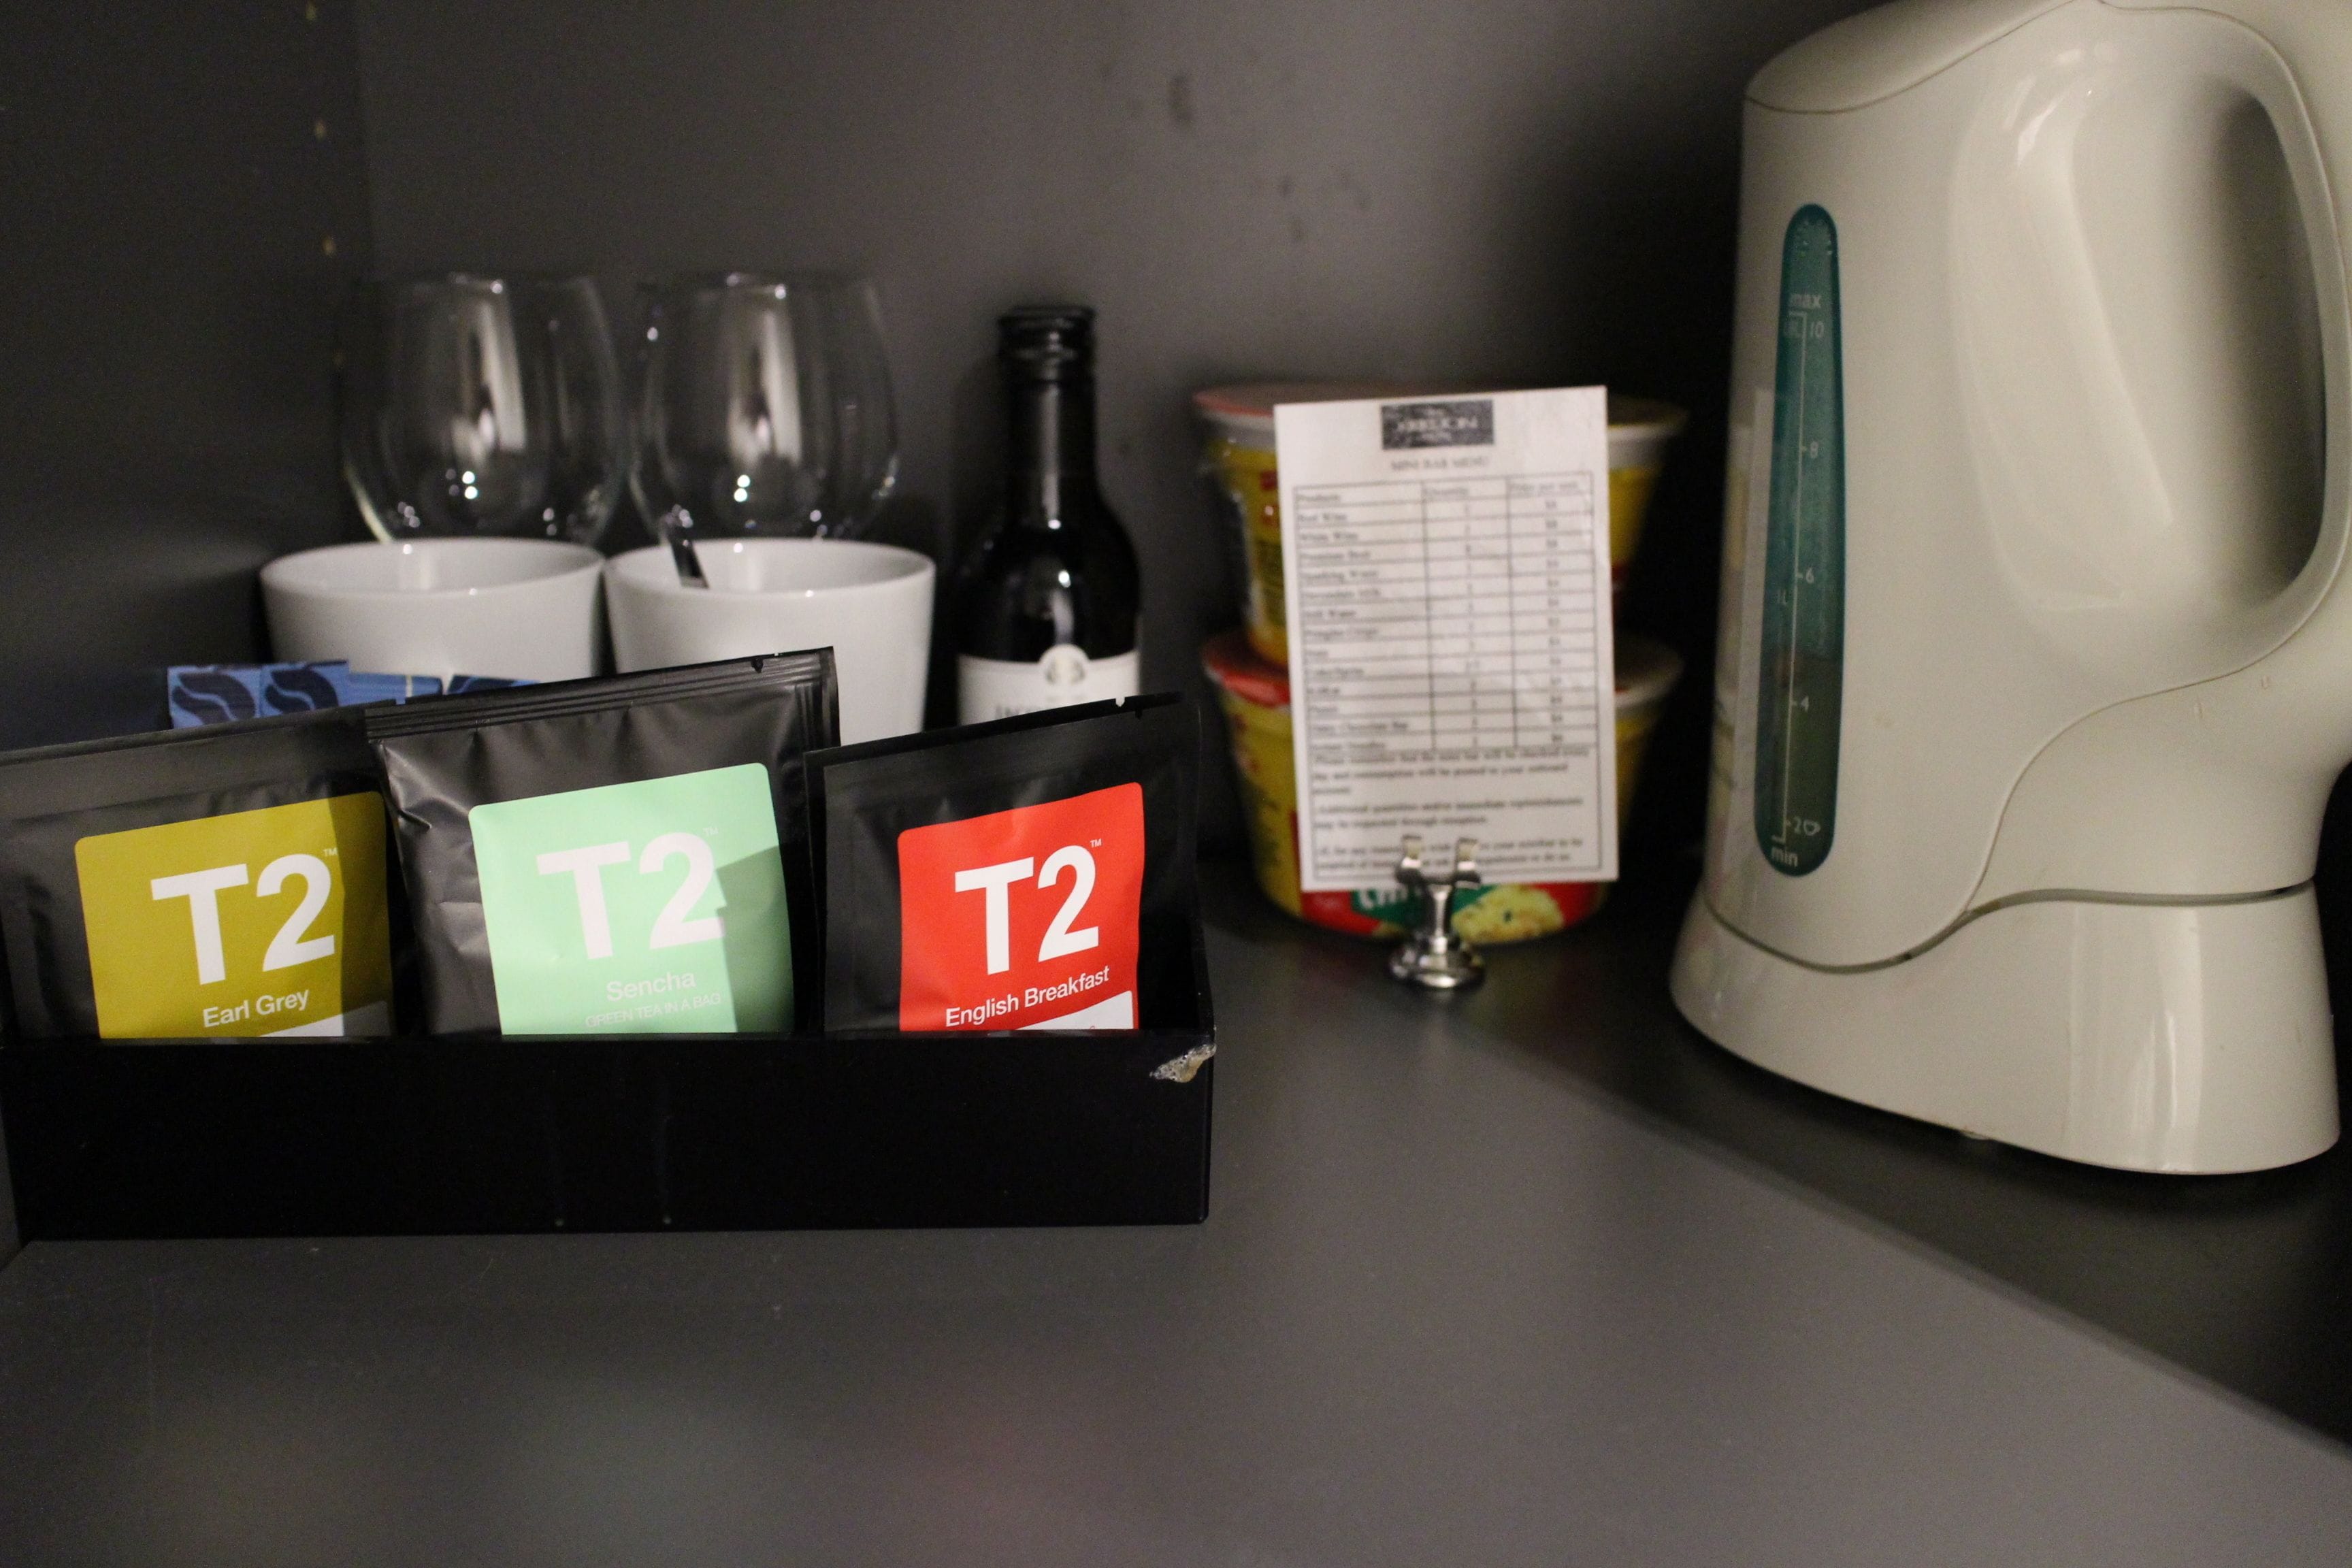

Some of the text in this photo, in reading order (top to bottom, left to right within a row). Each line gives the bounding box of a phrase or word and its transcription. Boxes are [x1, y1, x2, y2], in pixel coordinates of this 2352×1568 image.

[1788, 294, 1823, 310] max
[1810, 441, 1819, 460] 8
[1805, 566, 1815, 583] 6
[1800, 696, 1810, 713] 4
[1771, 847, 1799, 868] min
[536, 832, 725, 960] T2
[955, 845, 1099, 975] T2
[151, 853, 335, 985] T2
[606, 971, 697, 1001] Sencha
[945, 966, 1110, 1027] English Breakfast
[203, 990, 310, 1028] Earl Grey
[585, 992, 721, 1027] GREEN TEA IN A BAG
